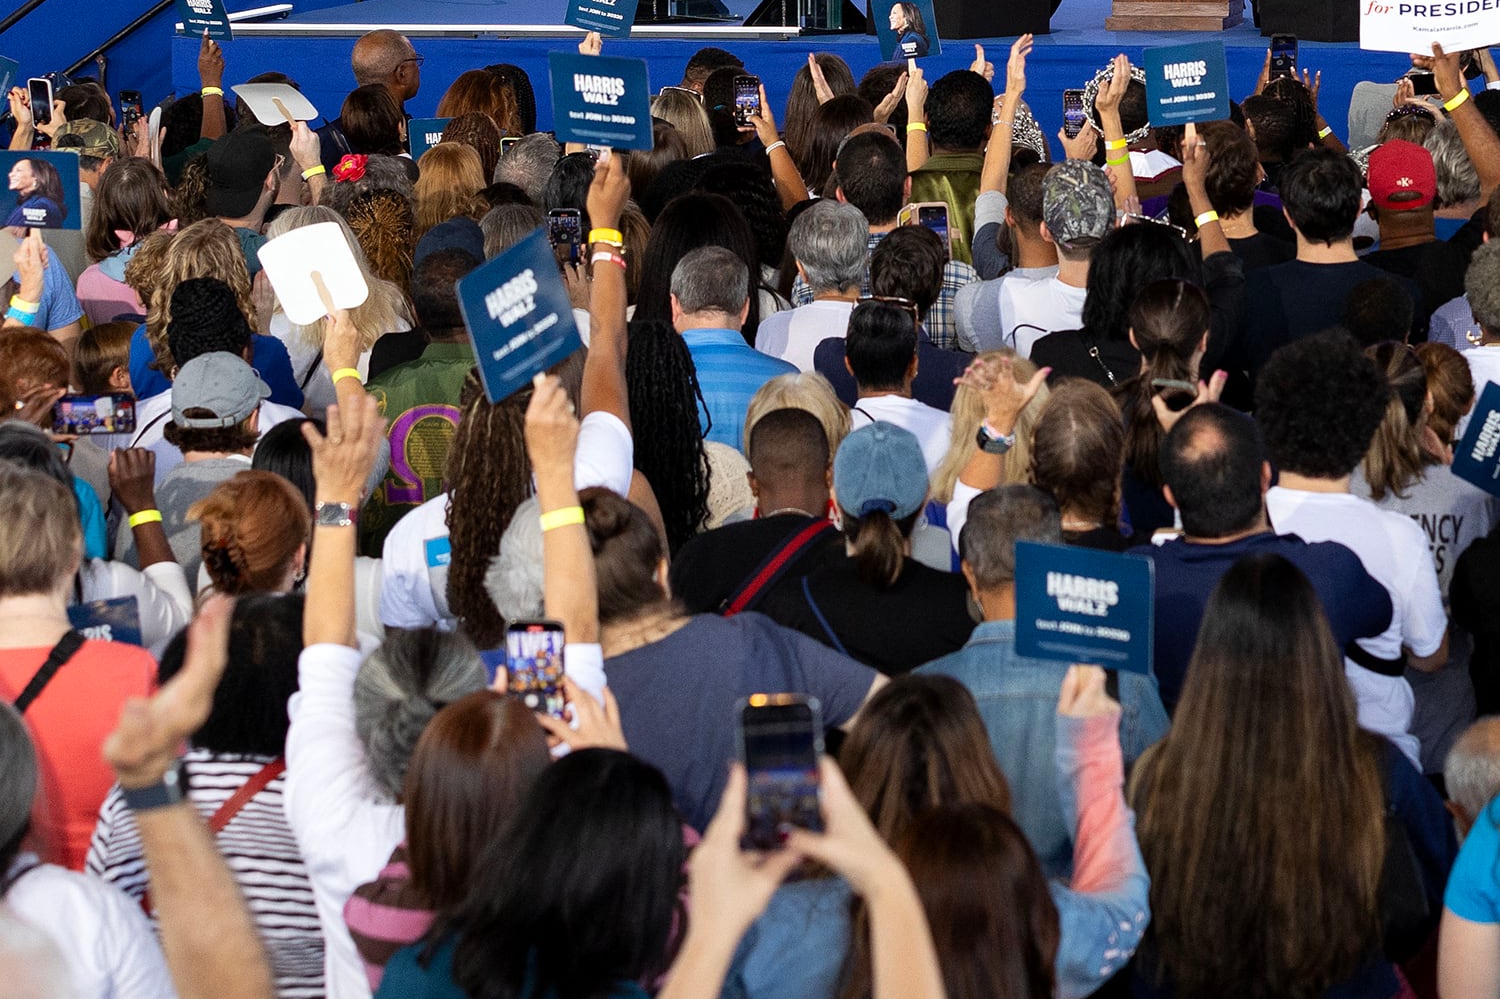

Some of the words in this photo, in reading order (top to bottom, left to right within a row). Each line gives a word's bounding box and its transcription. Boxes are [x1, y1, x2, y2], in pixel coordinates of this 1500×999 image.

[1364, 0, 1394, 16] for
[1164, 60, 1207, 80] HARRIS
[574, 73, 625, 96] HARRIS
[1171, 76, 1201, 88] WALZ
[583, 91, 619, 105] WALZ
[1046, 571, 1119, 606] HARRIS
[1057, 597, 1109, 617] WALZ
